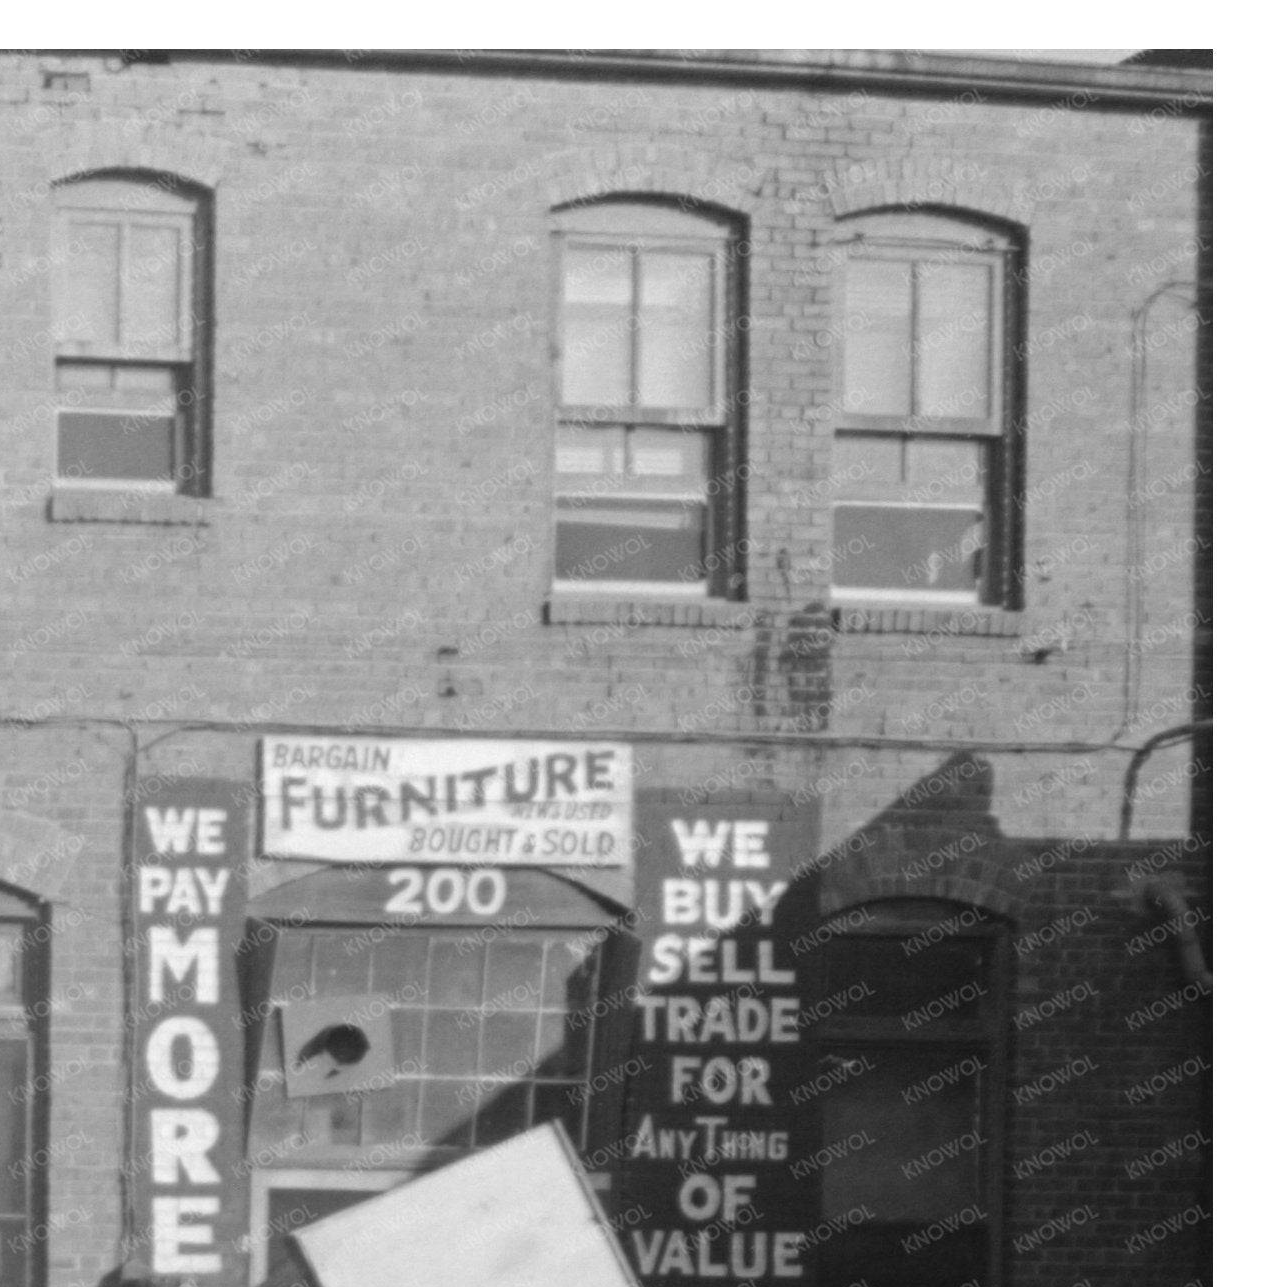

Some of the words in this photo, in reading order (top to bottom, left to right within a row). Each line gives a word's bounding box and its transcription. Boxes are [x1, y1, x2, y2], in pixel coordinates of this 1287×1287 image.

[274, 744, 391, 771] BARGAIN
[281, 750, 615, 830] FURNITURE
[145, 806, 226, 854] WE
[407, 827, 518, 853] BOUGHT
[523, 833, 536, 853] &
[542, 829, 616, 855] SOLD
[671, 820, 770, 868] WE
[139, 866, 228, 914] PAY
[383, 867, 507, 915] 200
[661, 879, 785, 927] BUY
[649, 940, 796, 984] SELL
[633, 997, 801, 1043] TRADE
[145, 927, 223, 1274] MORE
[671, 1056, 773, 1104] FOR
[678, 1175, 757, 1222] OF
[632, 1231, 804, 1277] VALUE
